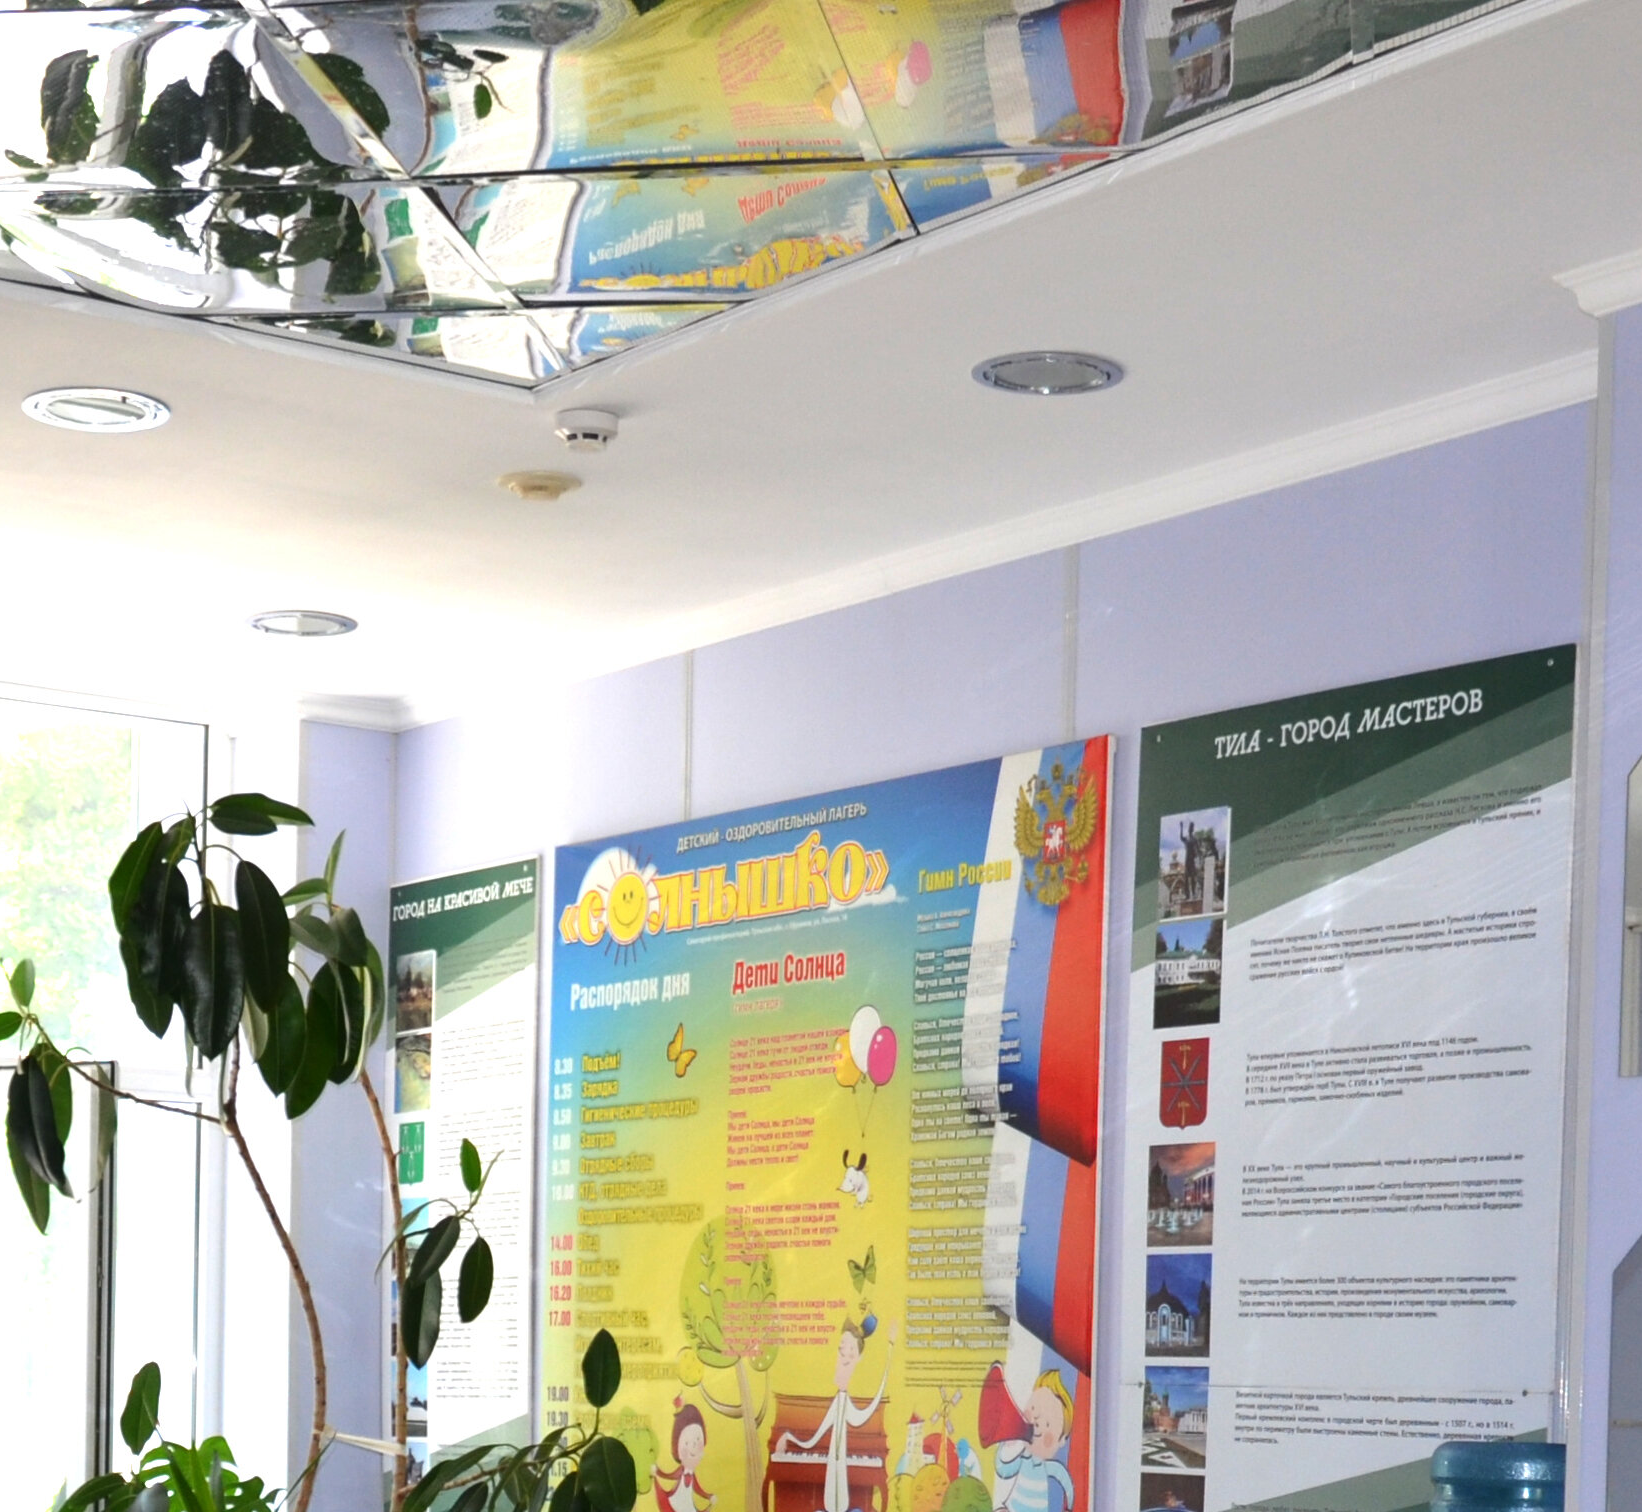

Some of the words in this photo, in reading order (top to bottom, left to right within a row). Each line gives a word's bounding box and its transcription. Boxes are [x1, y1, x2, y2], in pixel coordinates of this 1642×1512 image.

[1214, 730, 1260, 759] ТУЛА
[1280, 714, 1351, 747] ГОРОД
[1357, 688, 1484, 733] МАСТЕРОВ
[677, 831, 720, 853] ДЕТСКИЙ
[725, 808, 827, 843] ОЗДОРОВИТЕЛЬНЫЙ
[828, 803, 867, 822] ЛАГЕРЬ
[918, 869, 955, 894] Гимн
[959, 860, 1013, 887] России
[393, 902, 425, 922] ГОРОД
[427, 898, 441, 914] НА
[444, 882, 500, 911] КРАСИВОЙ
[502, 877, 534, 898] МЕЧЕ
[732, 960, 779, 995] Дети
[783, 951, 846, 985] Солнца
[570, 976, 658, 1011] Распорядок
[662, 972, 690, 1001] дня
[554, 1057, 573, 1075] 8.30
[582, 1051, 621, 1073] Подъём!
[554, 1082, 573, 1100] 8.35
[581, 1080, 619, 1098] Зарядка
[551, 1235, 574, 1251] 14.00
[550, 1260, 572, 1276] 16.00
[550, 1285, 572, 1301] 16.20
[549, 1311, 571, 1326] 17.00
